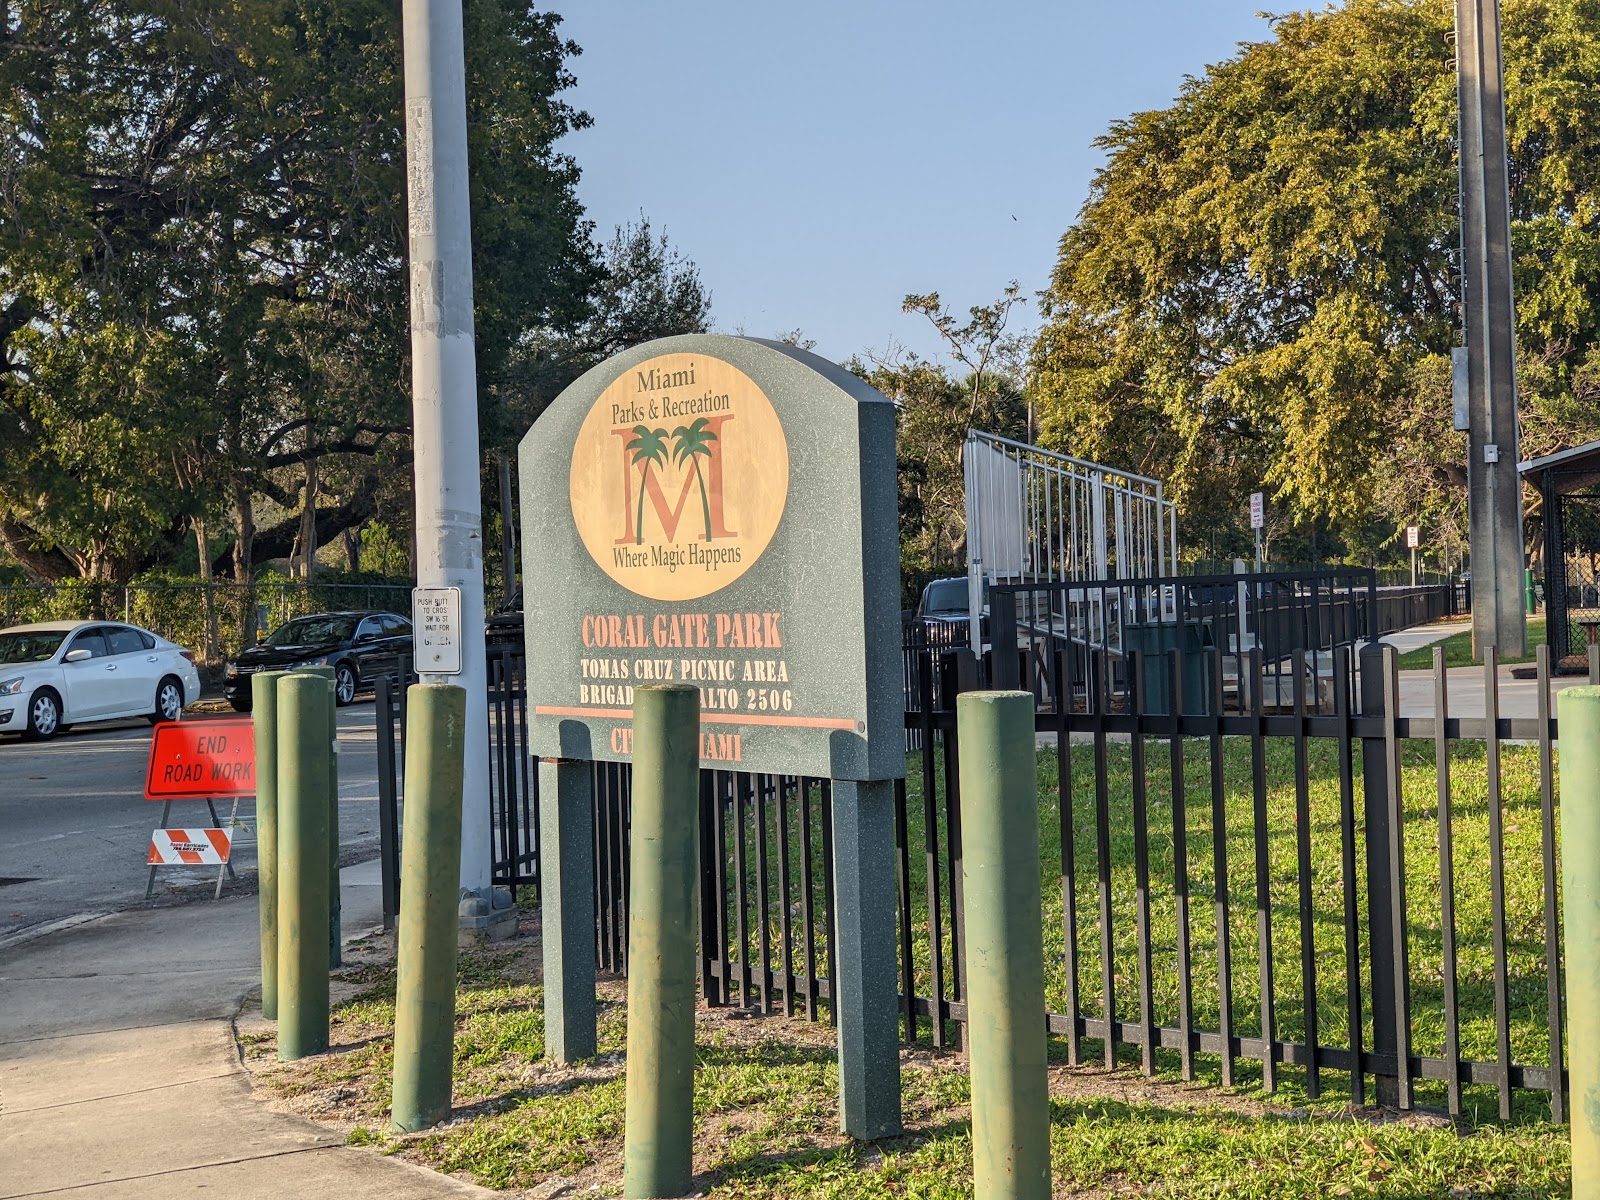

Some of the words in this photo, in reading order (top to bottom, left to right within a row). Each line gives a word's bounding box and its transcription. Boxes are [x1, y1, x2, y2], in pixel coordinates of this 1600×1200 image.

[637, 362, 696, 393] Miami
[611, 401, 645, 425] Parks
[648, 398, 659, 420] &
[662, 389, 730, 419] Recreation
[612, 547, 648, 569] Where
[650, 544, 686, 573] Magic
[688, 543, 742, 572] Happens
[417, 598, 433, 606] PUSH
[423, 606, 430, 614] TO
[432, 606, 449, 614] CROS
[425, 615, 434, 623] SW
[435, 615, 441, 623] 16
[442, 615, 448, 623] ST
[581, 613, 649, 648] CORAL
[653, 612, 710, 648] GATE
[715, 612, 782, 648] PARK
[580, 658, 629, 680] TOMAS
[634, 659, 673, 680] CRUZ
[681, 659, 735, 681] PICNIC
[742, 660, 789, 682] AREA
[580, 684, 634, 706] BRIGAD
[699, 687, 739, 710] ALTO
[747, 688, 793, 711] 2506
[196, 735, 227, 754] END
[698, 733, 742, 762] IAMI
[164, 764, 203, 783] ROAD
[211, 762, 253, 781] WORK
